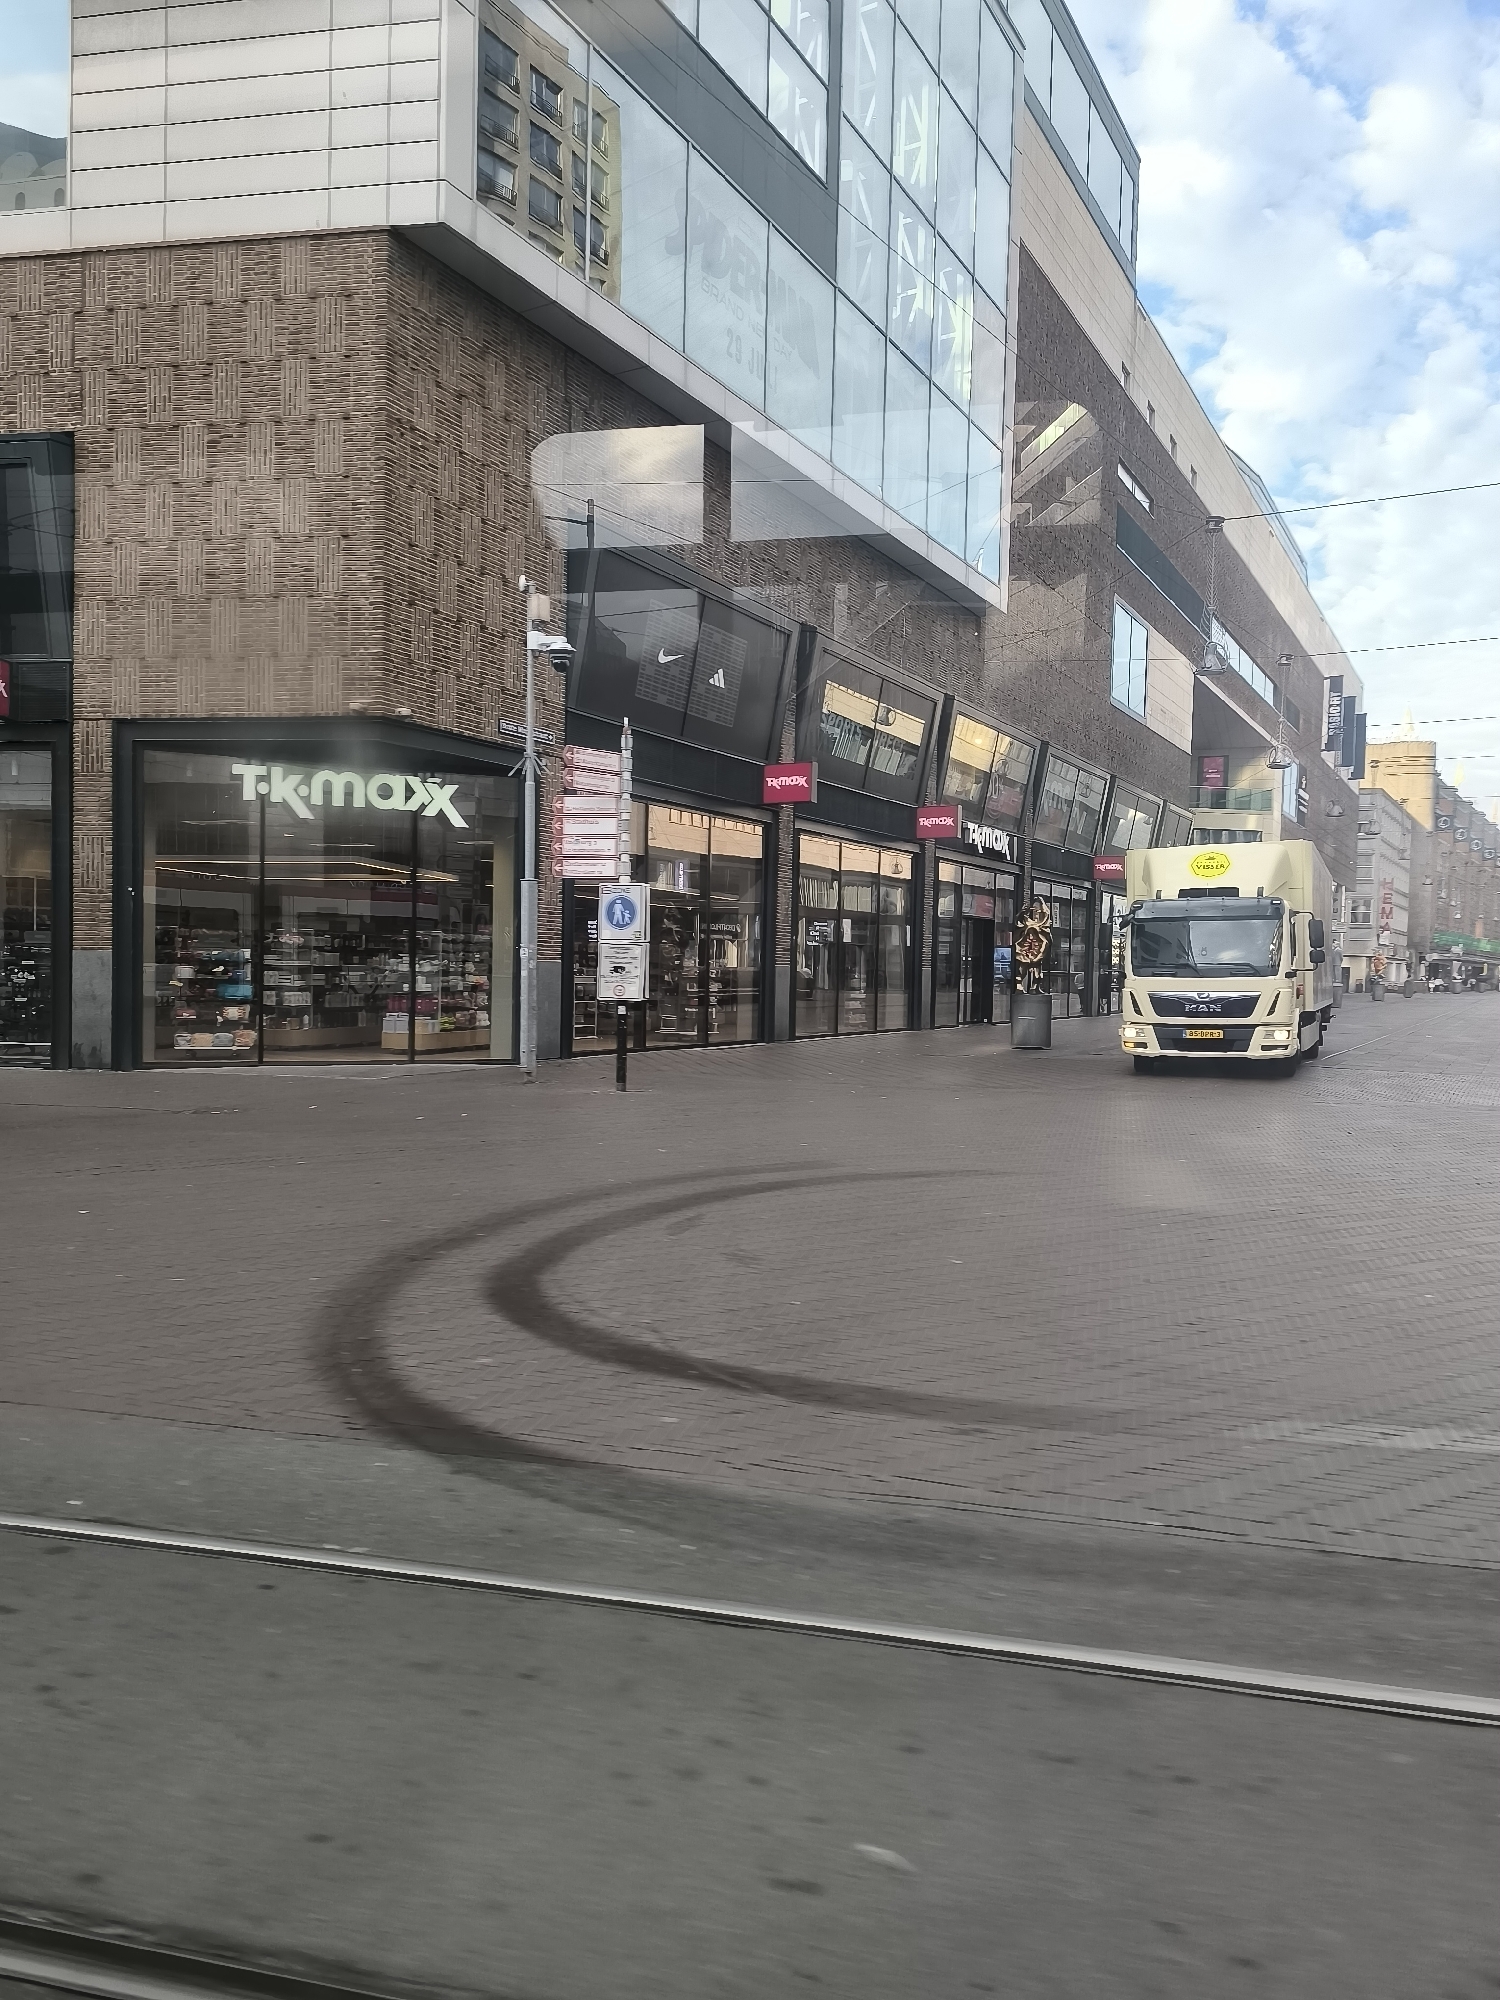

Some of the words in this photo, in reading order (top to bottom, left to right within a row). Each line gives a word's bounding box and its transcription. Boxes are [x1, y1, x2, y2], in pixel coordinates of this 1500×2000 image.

[701, 277, 745, 321] BRAND
[773, 336, 794, 362] DAY
[726, 327, 743, 365] 29
[820, 713, 863, 741] SPORTS
[1379, 878, 1394, 935] HEMA
[1184, 1004, 1222, 1012] MAN
